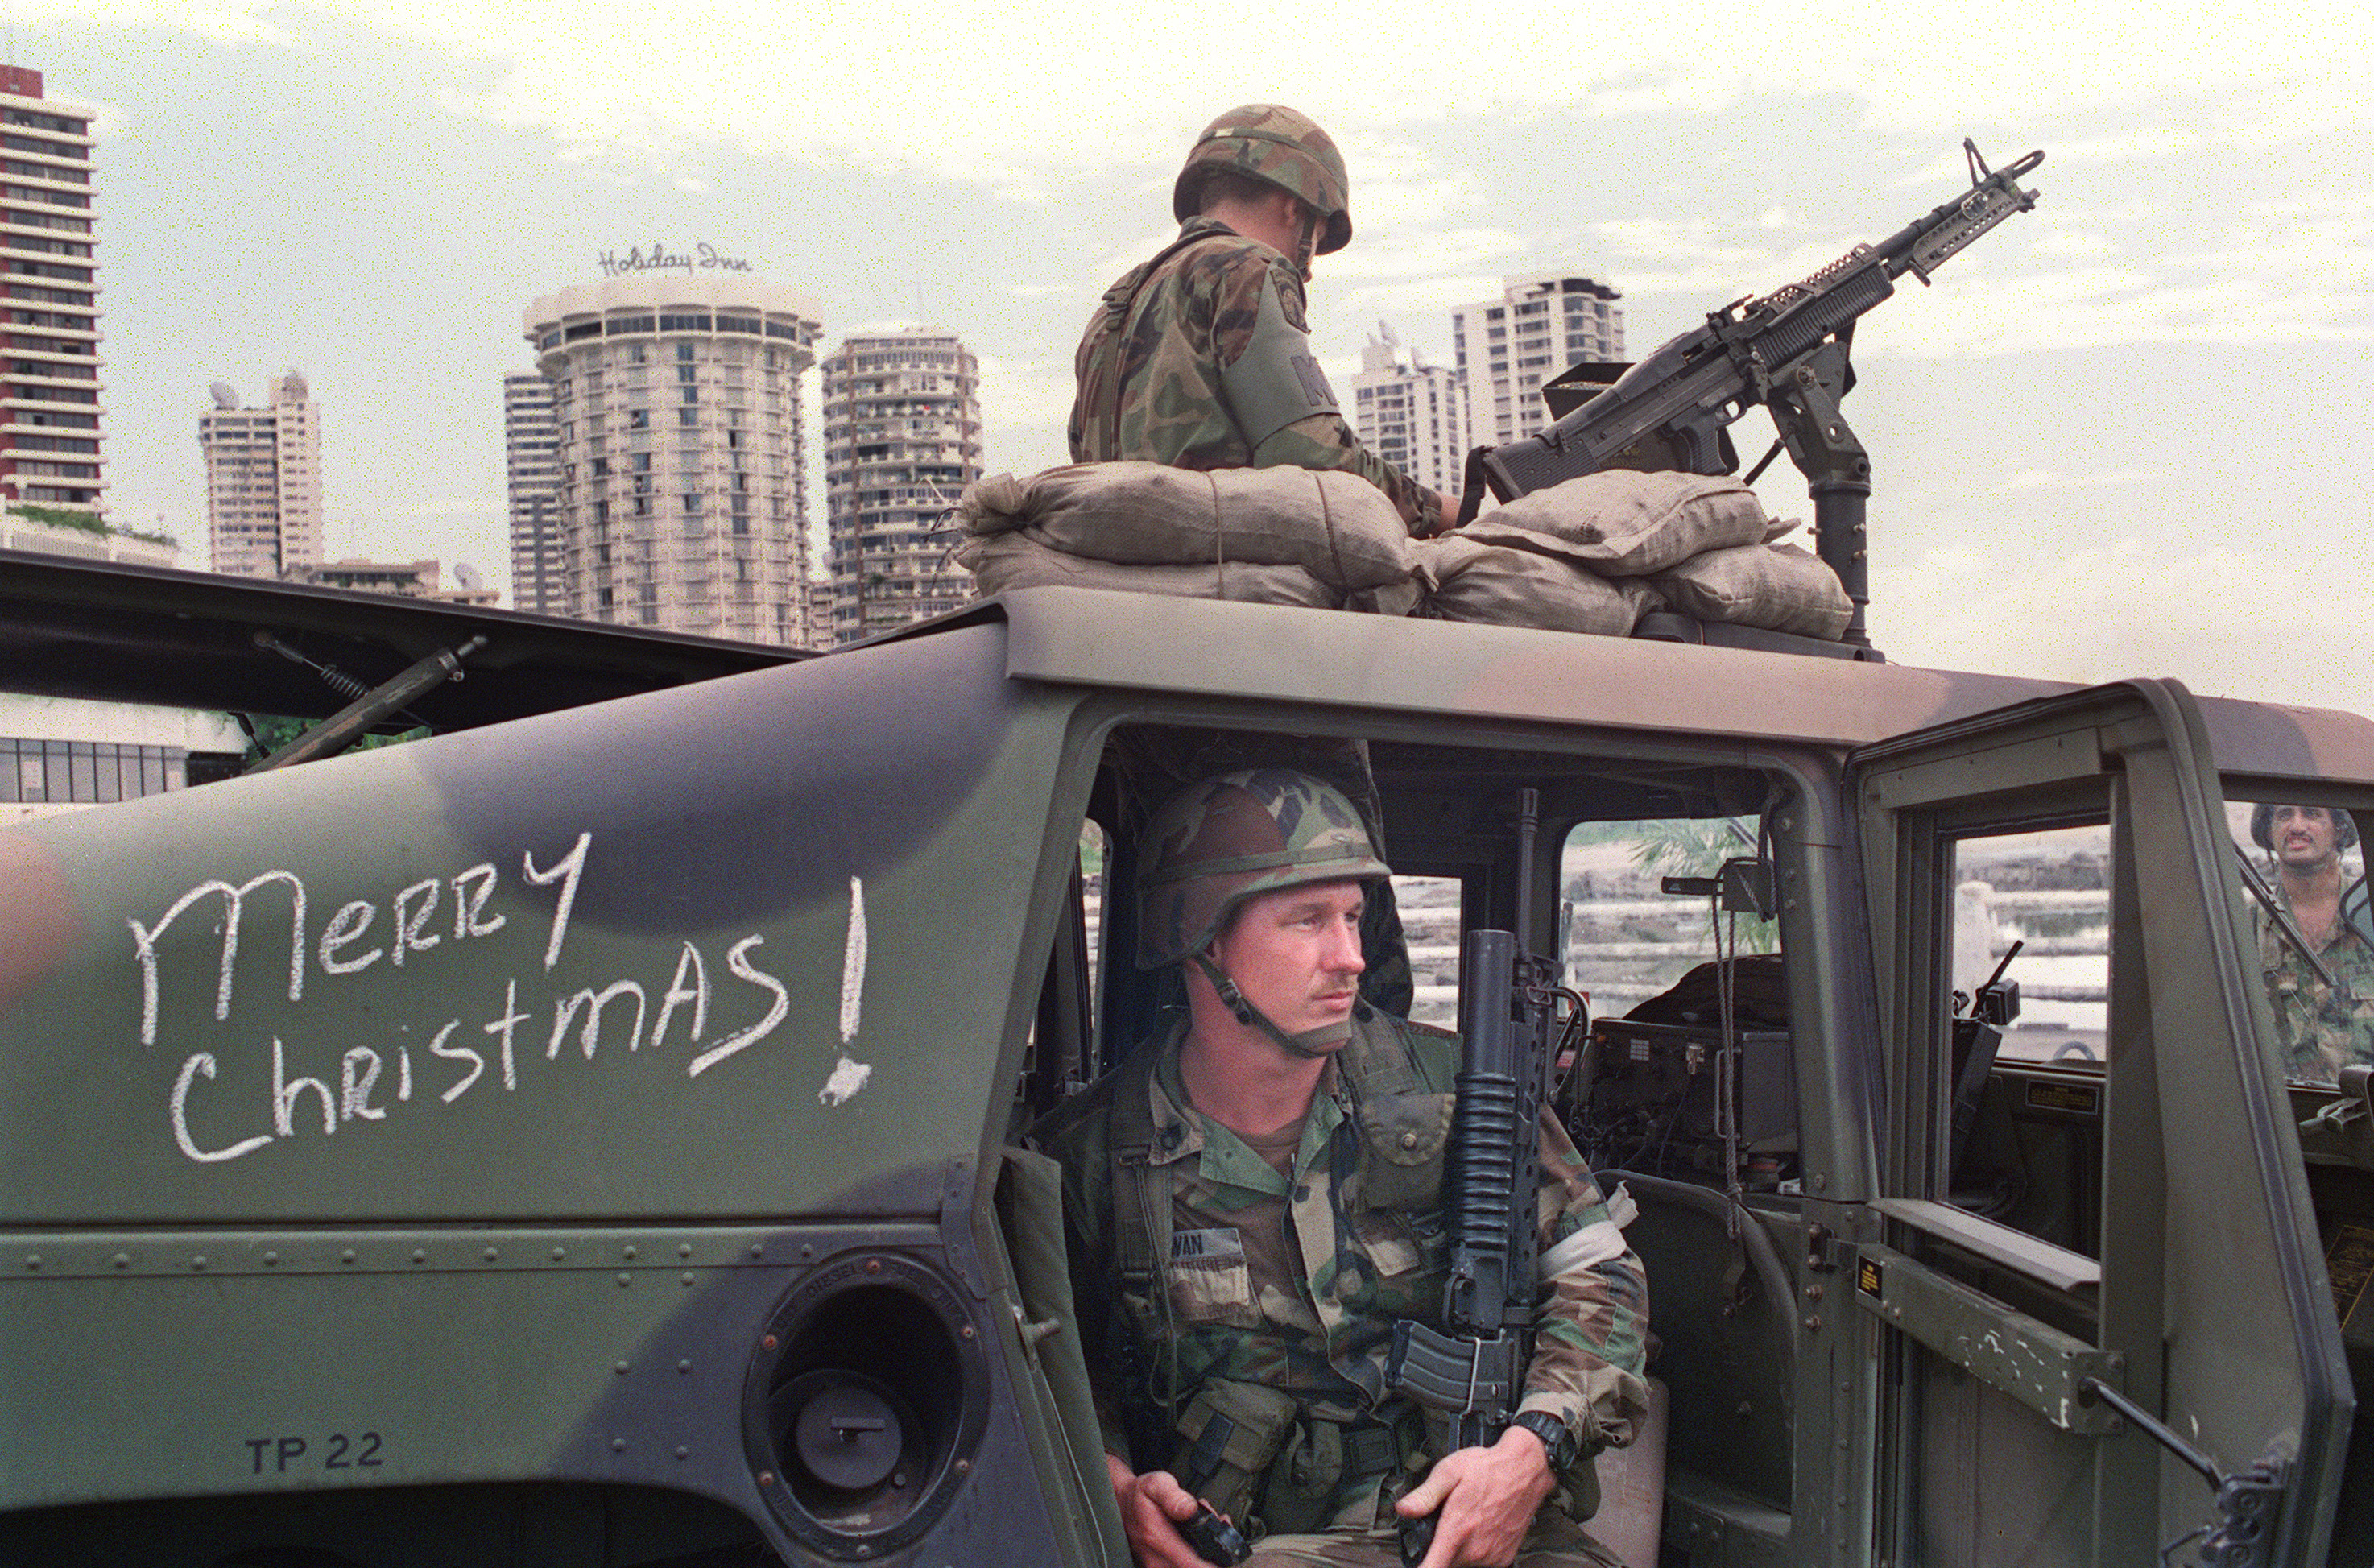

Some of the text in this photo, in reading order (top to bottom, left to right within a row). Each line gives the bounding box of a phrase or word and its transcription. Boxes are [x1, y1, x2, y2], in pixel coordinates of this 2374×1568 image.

[598, 242, 753, 276] Holiday Inn
[245, 1431, 383, 1474] TP 22
